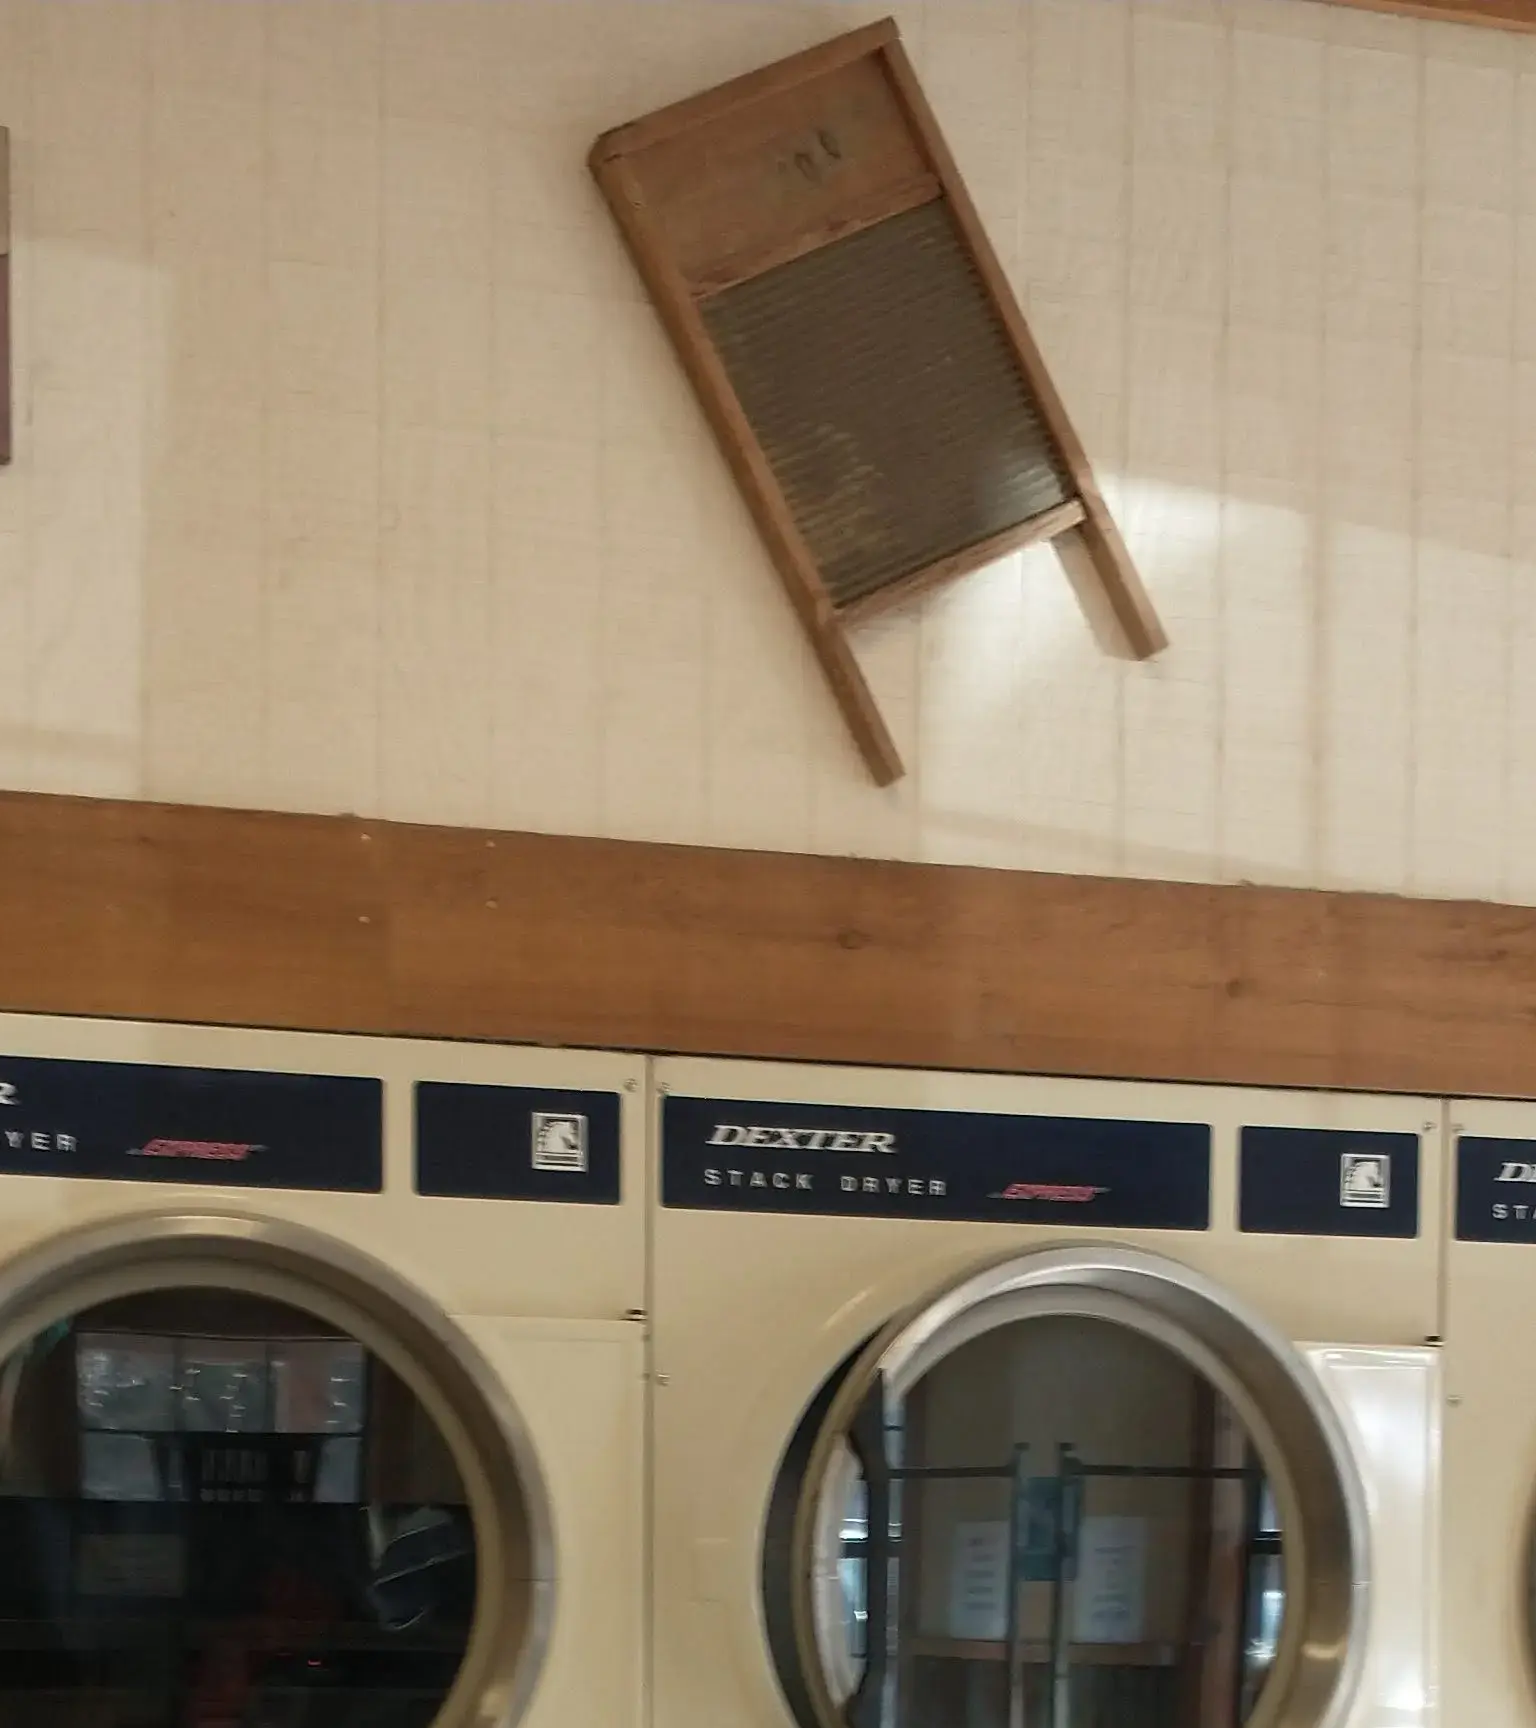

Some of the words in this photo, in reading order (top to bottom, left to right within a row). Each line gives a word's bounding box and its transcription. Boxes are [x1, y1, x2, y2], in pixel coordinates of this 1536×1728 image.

[705, 1125, 897, 1153] DEXTER
[704, 1168, 813, 1190] STACK
[840, 1175, 947, 1196] DRYER
